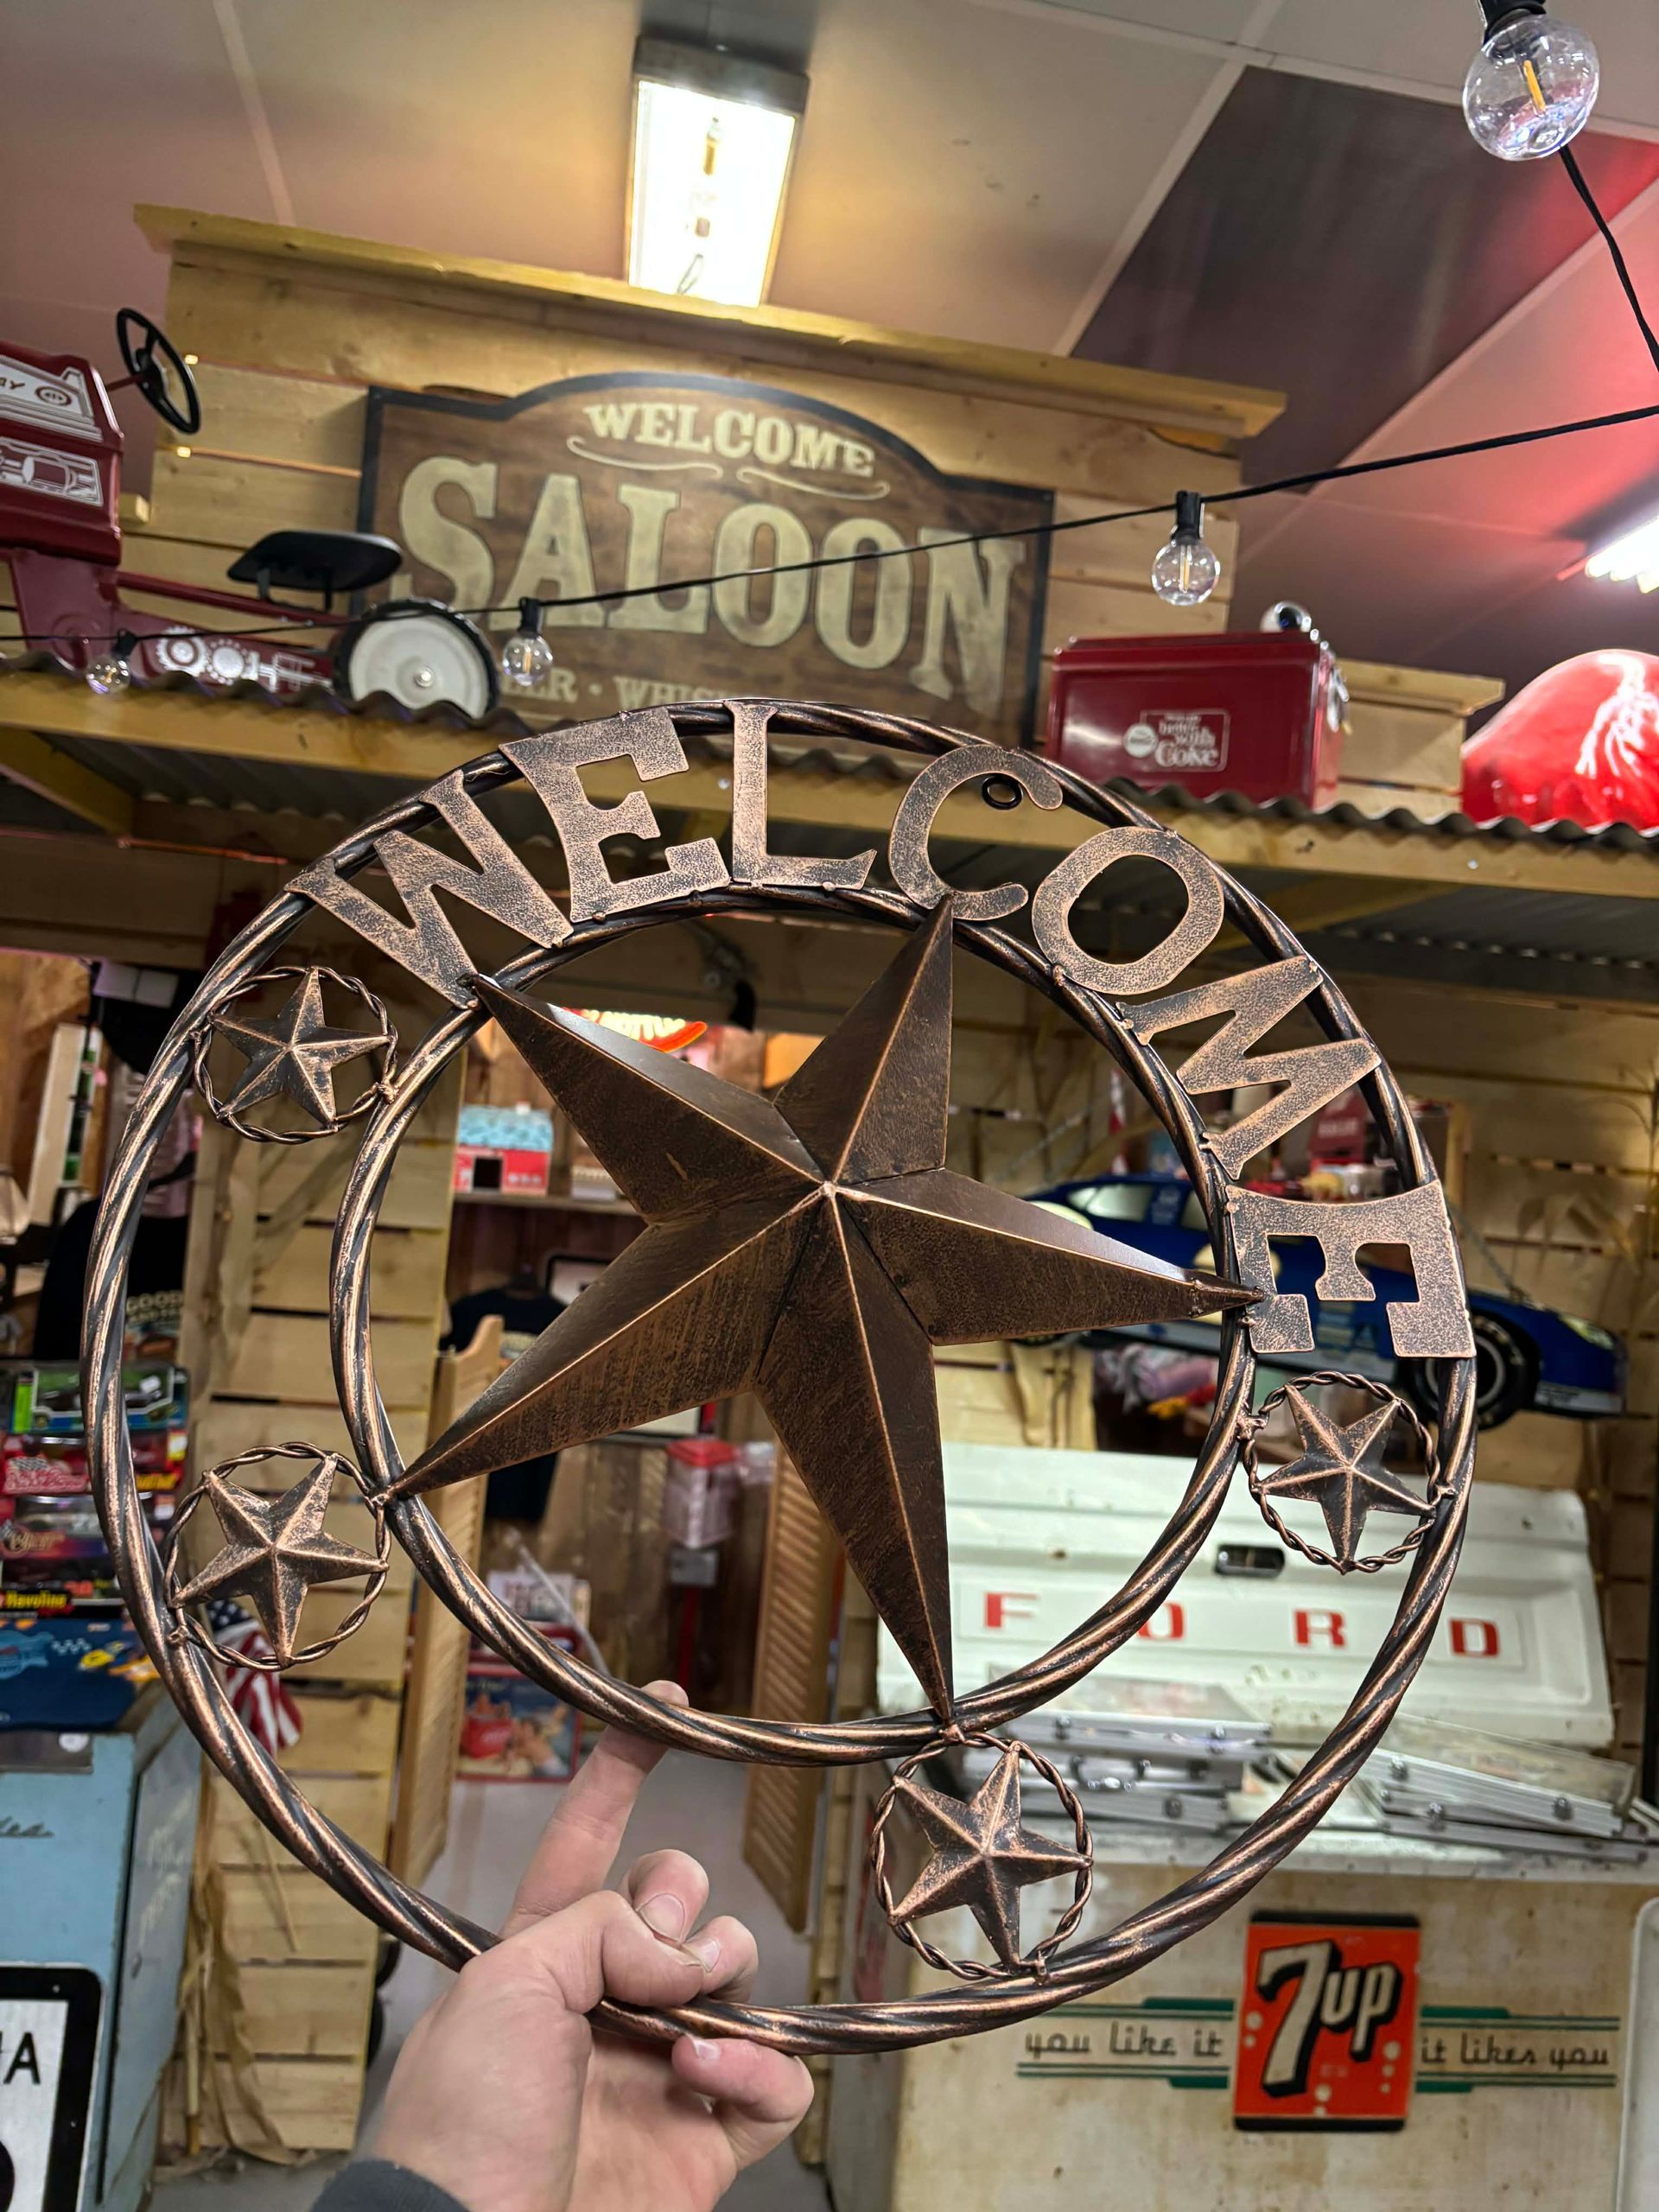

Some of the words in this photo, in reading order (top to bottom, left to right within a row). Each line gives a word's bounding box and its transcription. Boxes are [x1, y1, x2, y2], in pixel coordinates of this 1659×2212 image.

[582, 402, 875, 477] WELCOME
[391, 455, 1025, 719] SALOON
[1154, 741, 1220, 768] Coke
[285, 698, 1477, 1359] WELCOME
[983, 1591, 1499, 1658] FORD
[0, 2031, 41, 2086] A
[1024, 2031, 1090, 2060] you
[1109, 2020, 1178, 2056] like
[1193, 2028, 1224, 2056] it
[1421, 2036, 1447, 2063] it
[1459, 2031, 1537, 2065] likes
[1549, 2045, 1609, 2071] you
